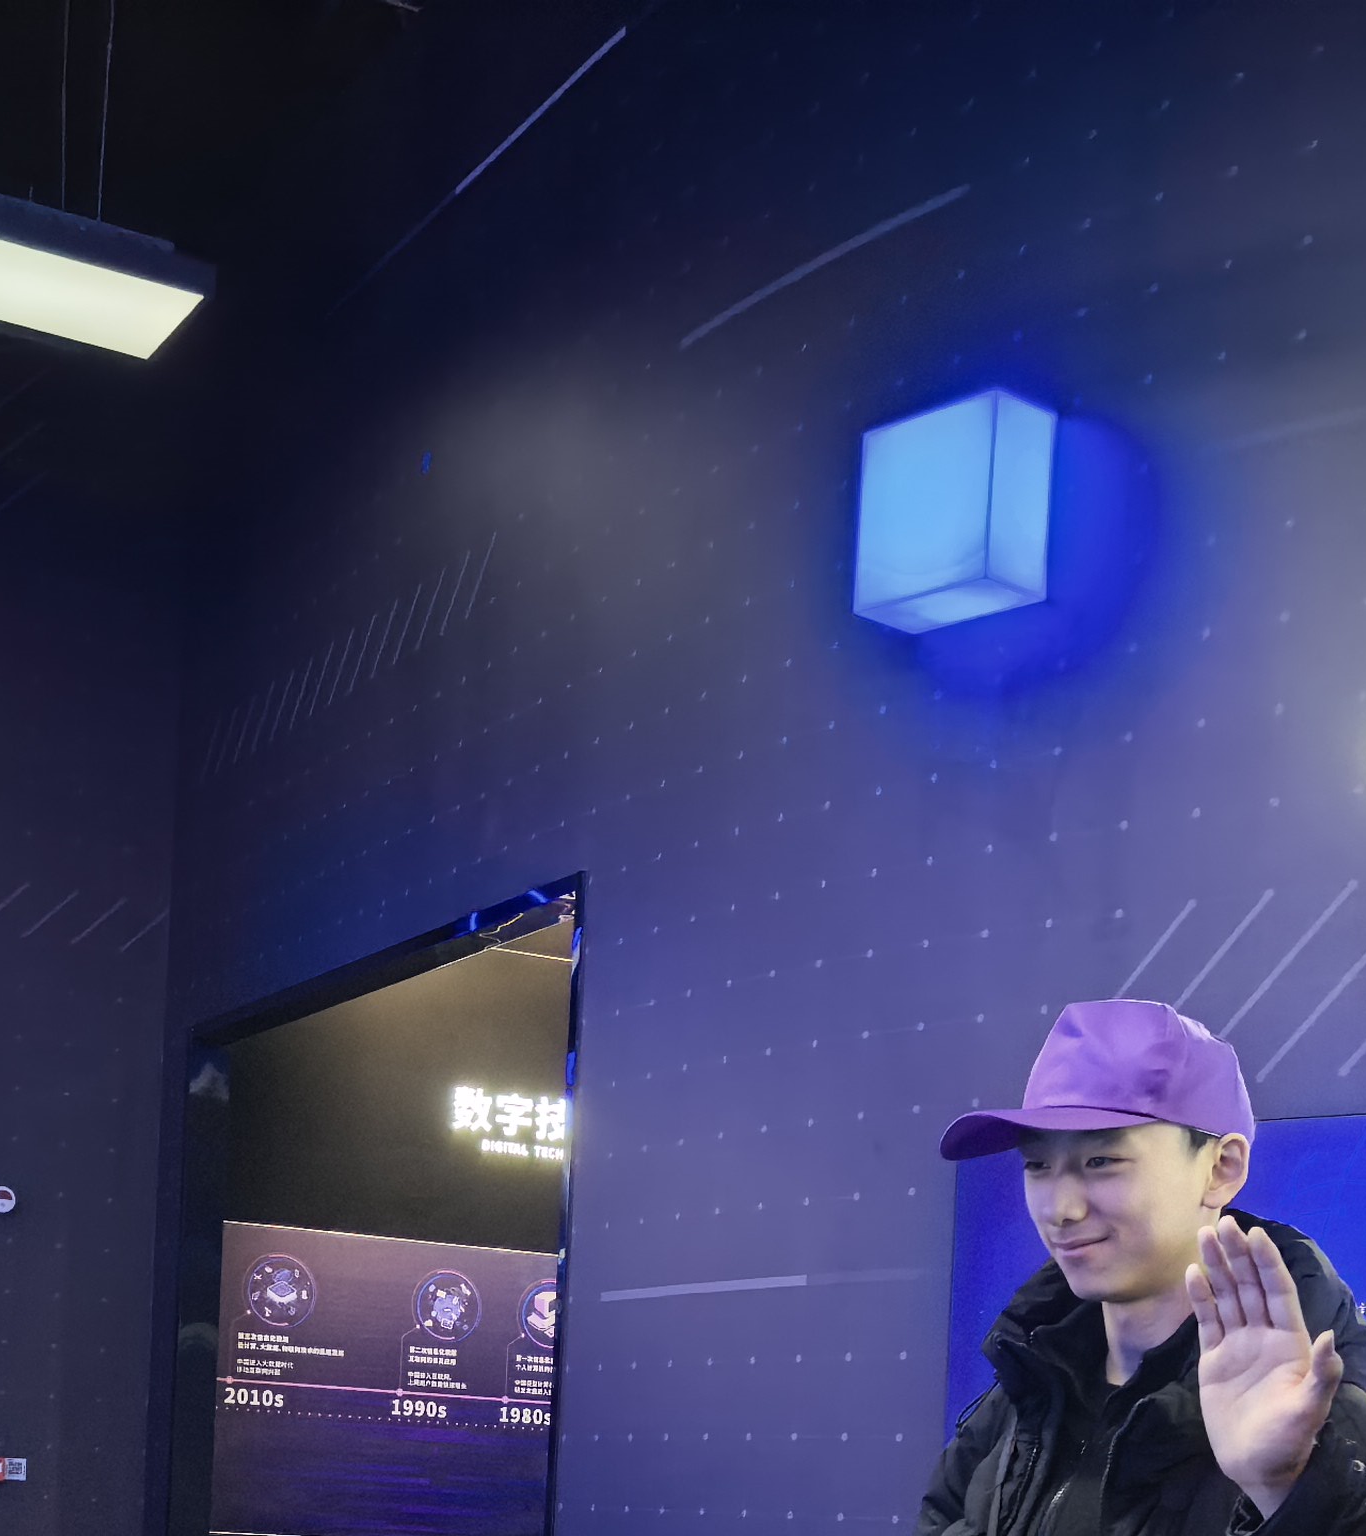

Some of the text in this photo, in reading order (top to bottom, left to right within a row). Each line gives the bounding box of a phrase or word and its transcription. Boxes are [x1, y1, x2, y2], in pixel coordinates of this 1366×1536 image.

[452, 1085, 567, 1142] 数字技
[223, 1387, 285, 1408] 2010s
[391, 1399, 448, 1419] 1990s
